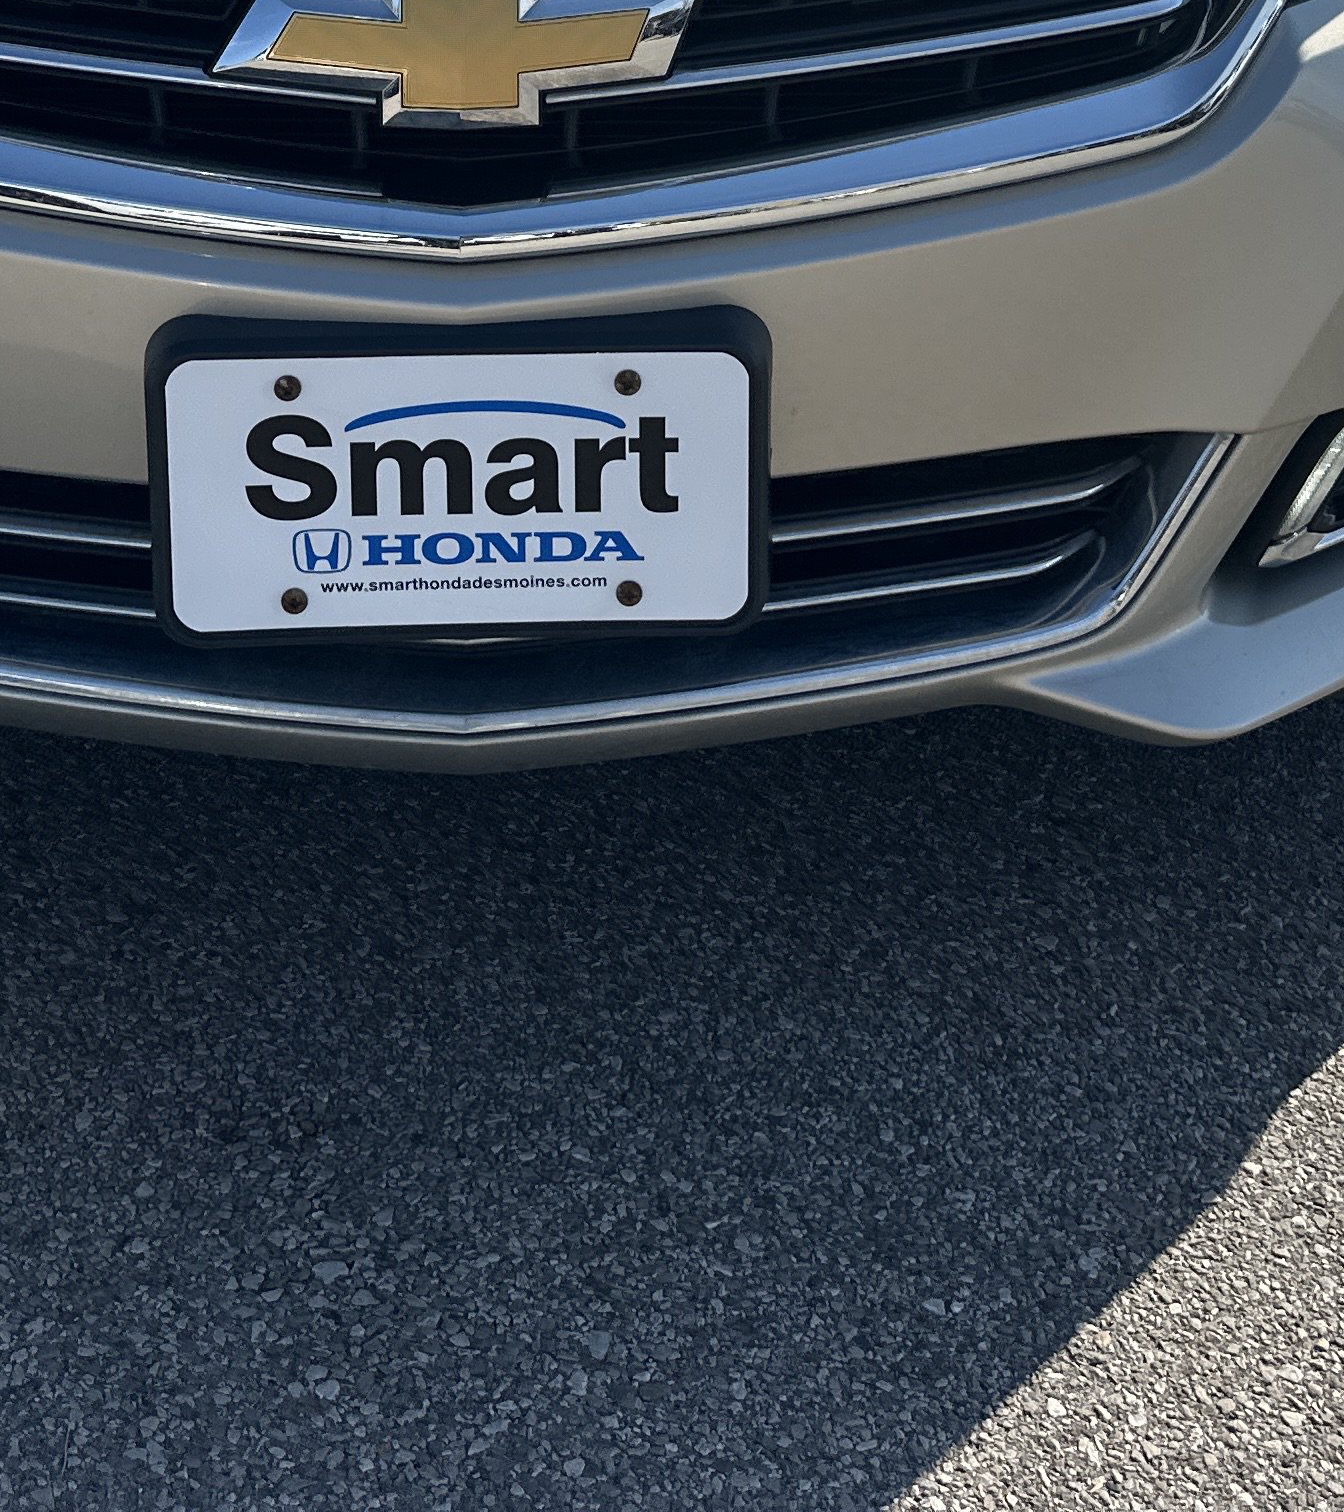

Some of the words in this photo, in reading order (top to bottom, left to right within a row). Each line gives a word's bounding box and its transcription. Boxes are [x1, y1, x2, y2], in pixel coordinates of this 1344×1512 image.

[244, 414, 680, 521] Smart
[361, 530, 645, 566] HONDA
[320, 573, 608, 593] www.smarthondadesmoines.com
